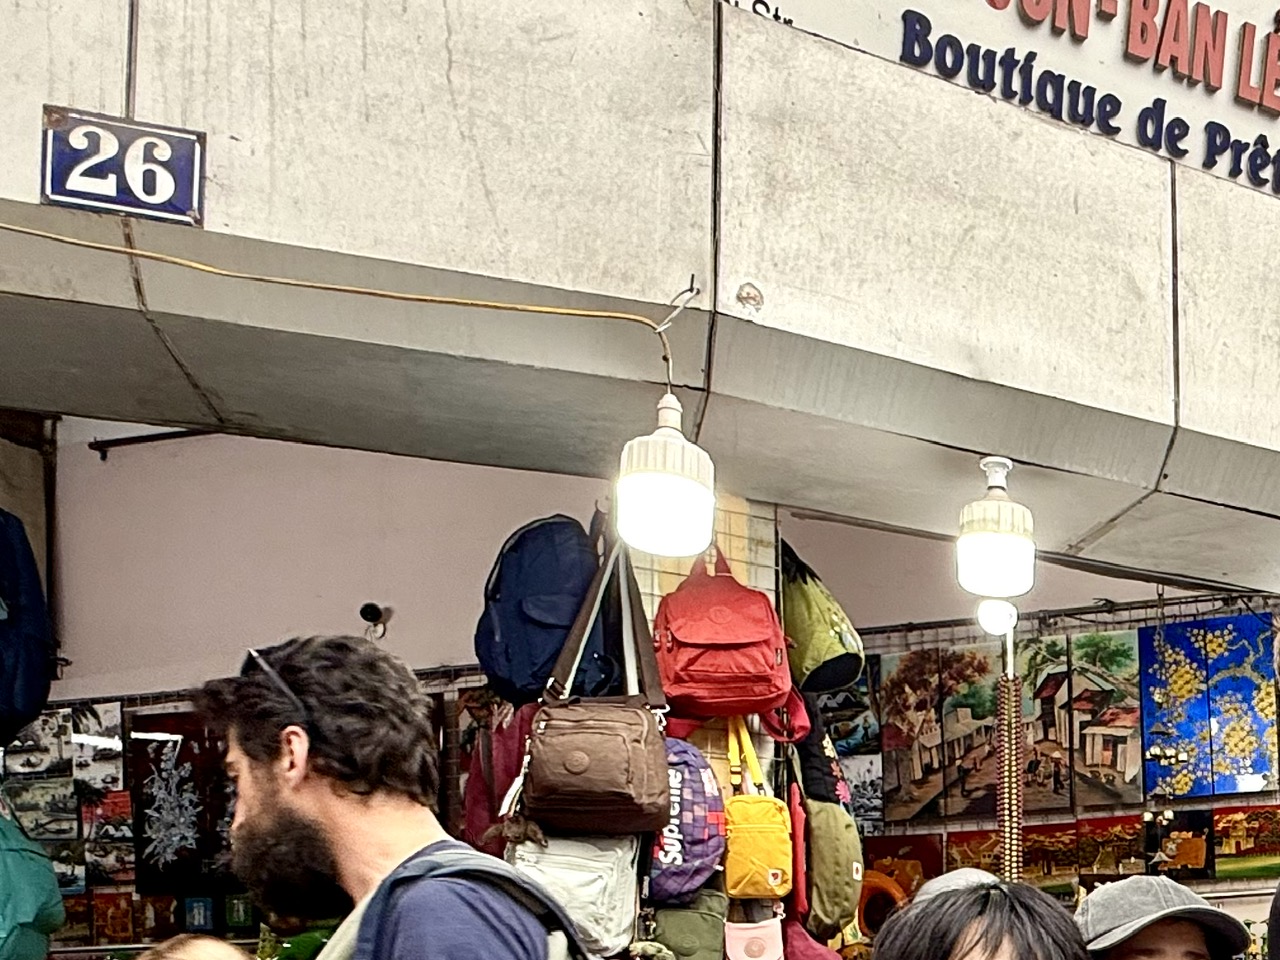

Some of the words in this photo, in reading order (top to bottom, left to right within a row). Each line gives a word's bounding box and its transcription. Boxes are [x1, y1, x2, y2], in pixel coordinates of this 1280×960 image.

[901, 10, 1122, 136] Boutique
[1137, 98, 1190, 159] de
[66, 125, 176, 206] 26
